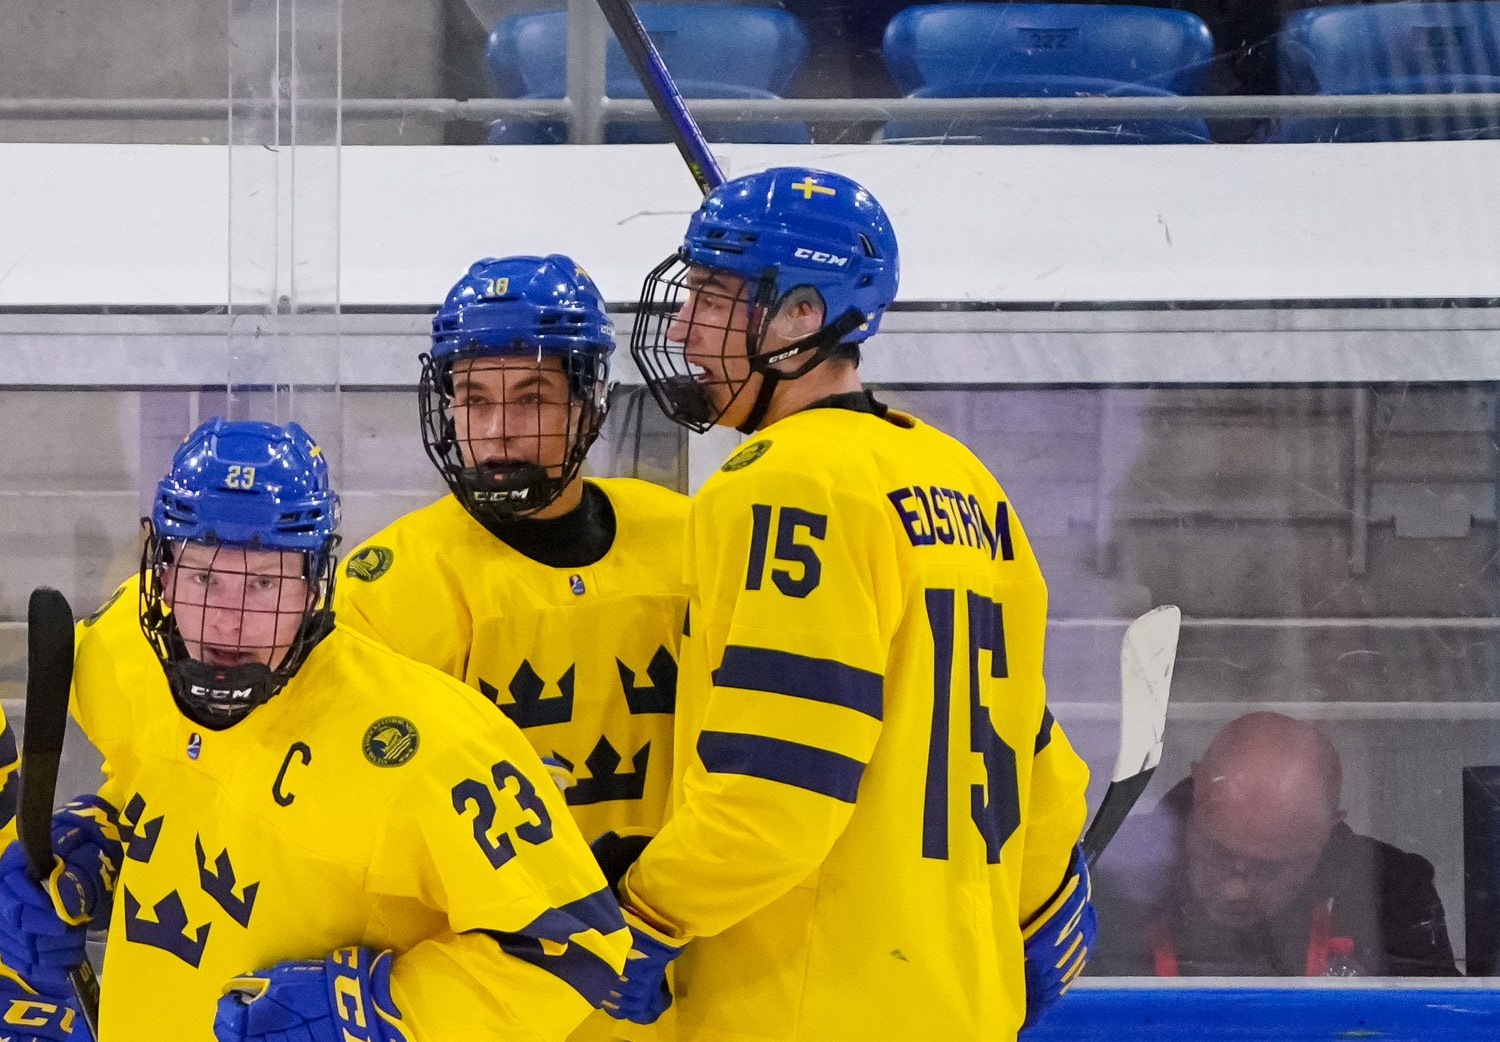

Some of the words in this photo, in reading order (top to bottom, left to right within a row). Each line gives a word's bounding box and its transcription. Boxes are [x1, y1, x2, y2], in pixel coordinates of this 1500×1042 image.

[794, 247, 848, 267] CCM
[484, 277, 510, 298] 18
[768, 347, 799, 363] CCM
[225, 465, 256, 489] 23
[886, 485, 1015, 562] EDSTRM
[745, 503, 829, 599] 15
[191, 684, 252, 700] CCM
[922, 588, 1022, 865] 15
[272, 740, 312, 808] C
[451, 759, 554, 871] 23
